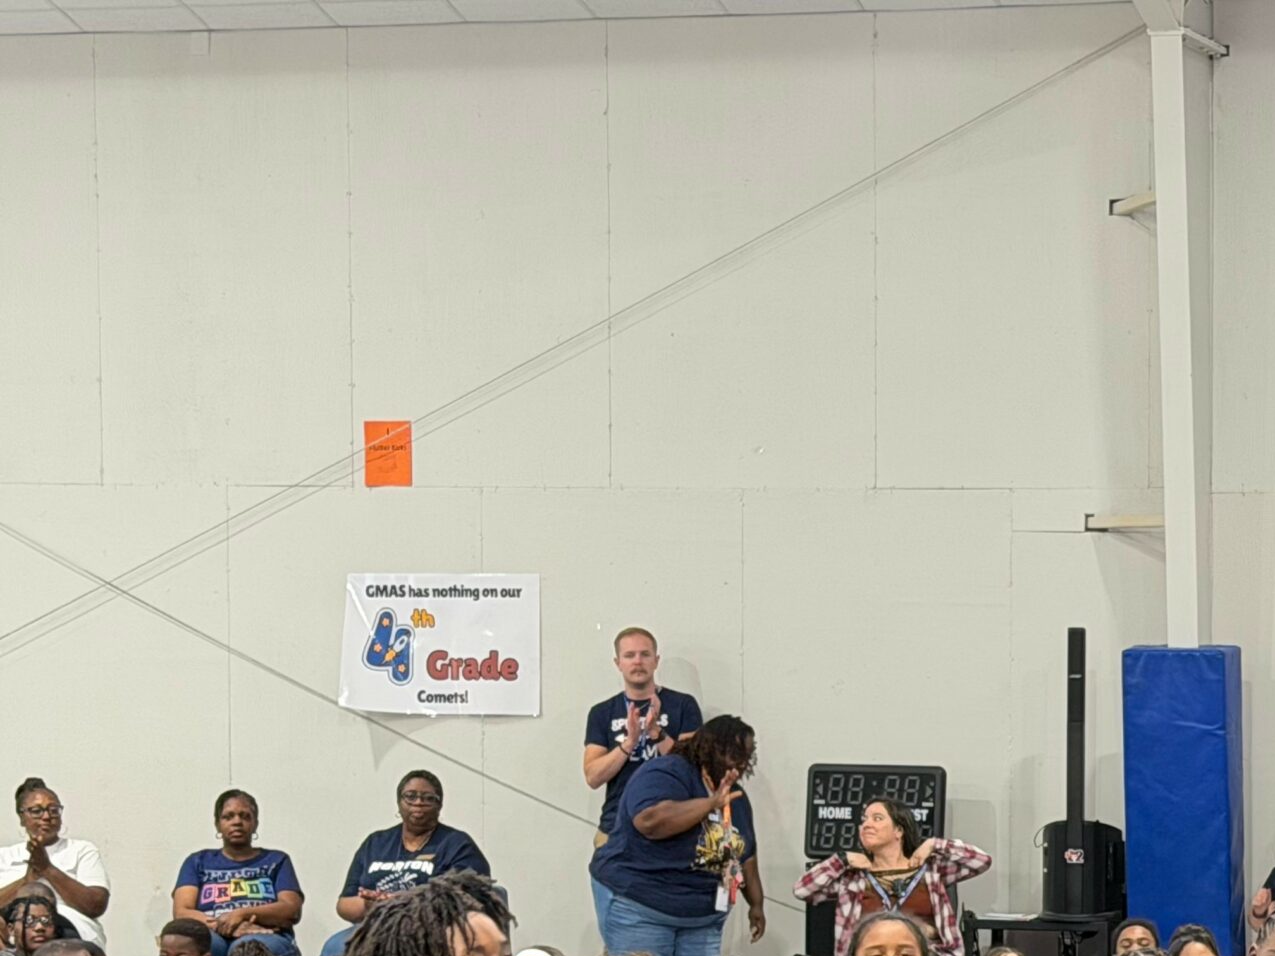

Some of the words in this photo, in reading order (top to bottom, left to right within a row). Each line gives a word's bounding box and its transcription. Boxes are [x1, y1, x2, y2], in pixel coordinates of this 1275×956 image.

[365, 584, 407, 599] GMAS
[408, 585, 430, 598] has
[432, 584, 480, 601] nothing
[482, 587, 498, 599] on
[500, 587, 523, 599] our
[426, 650, 520, 681] Grade
[416, 689, 469, 704] Comets!
[818, 806, 853, 820] HOME
[202, 879, 274, 902] GRADE
